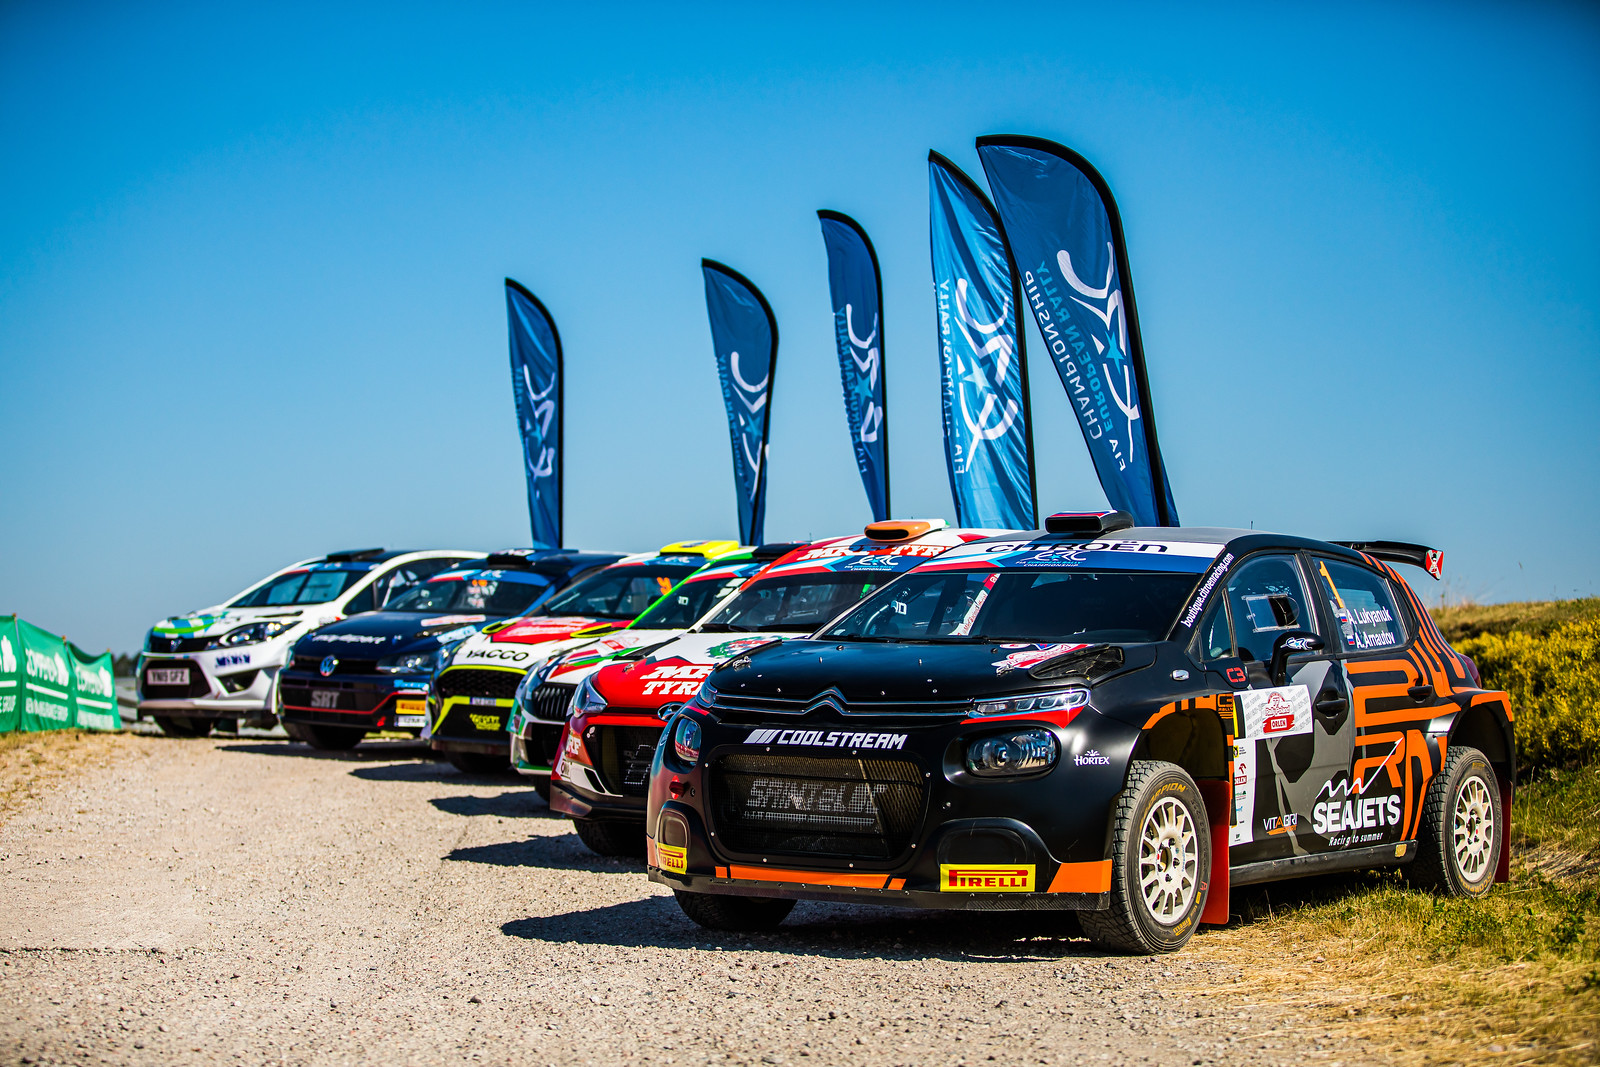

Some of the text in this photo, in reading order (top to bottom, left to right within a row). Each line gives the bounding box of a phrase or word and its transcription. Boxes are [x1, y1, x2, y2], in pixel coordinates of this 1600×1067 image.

[890, 545, 952, 557] TYR
[1181, 553, 1234, 628] boutique.citroenracing.com
[1355, 606, 1393, 627] Lukyanuk
[1364, 630, 1395, 648] Arnautov
[466, 649, 529, 662] YACCO
[640, 666, 714, 679] MR
[1226, 667, 1246, 682] C3
[642, 681, 704, 695] TYR
[1272, 719, 1287, 728] ORLEN
[776, 729, 908, 750] COOLSTREAM
[1312, 794, 1401, 835] SEAJETS
[1360, 832, 1384, 843] summer
[948, 869, 1029, 888] PIRELLI
